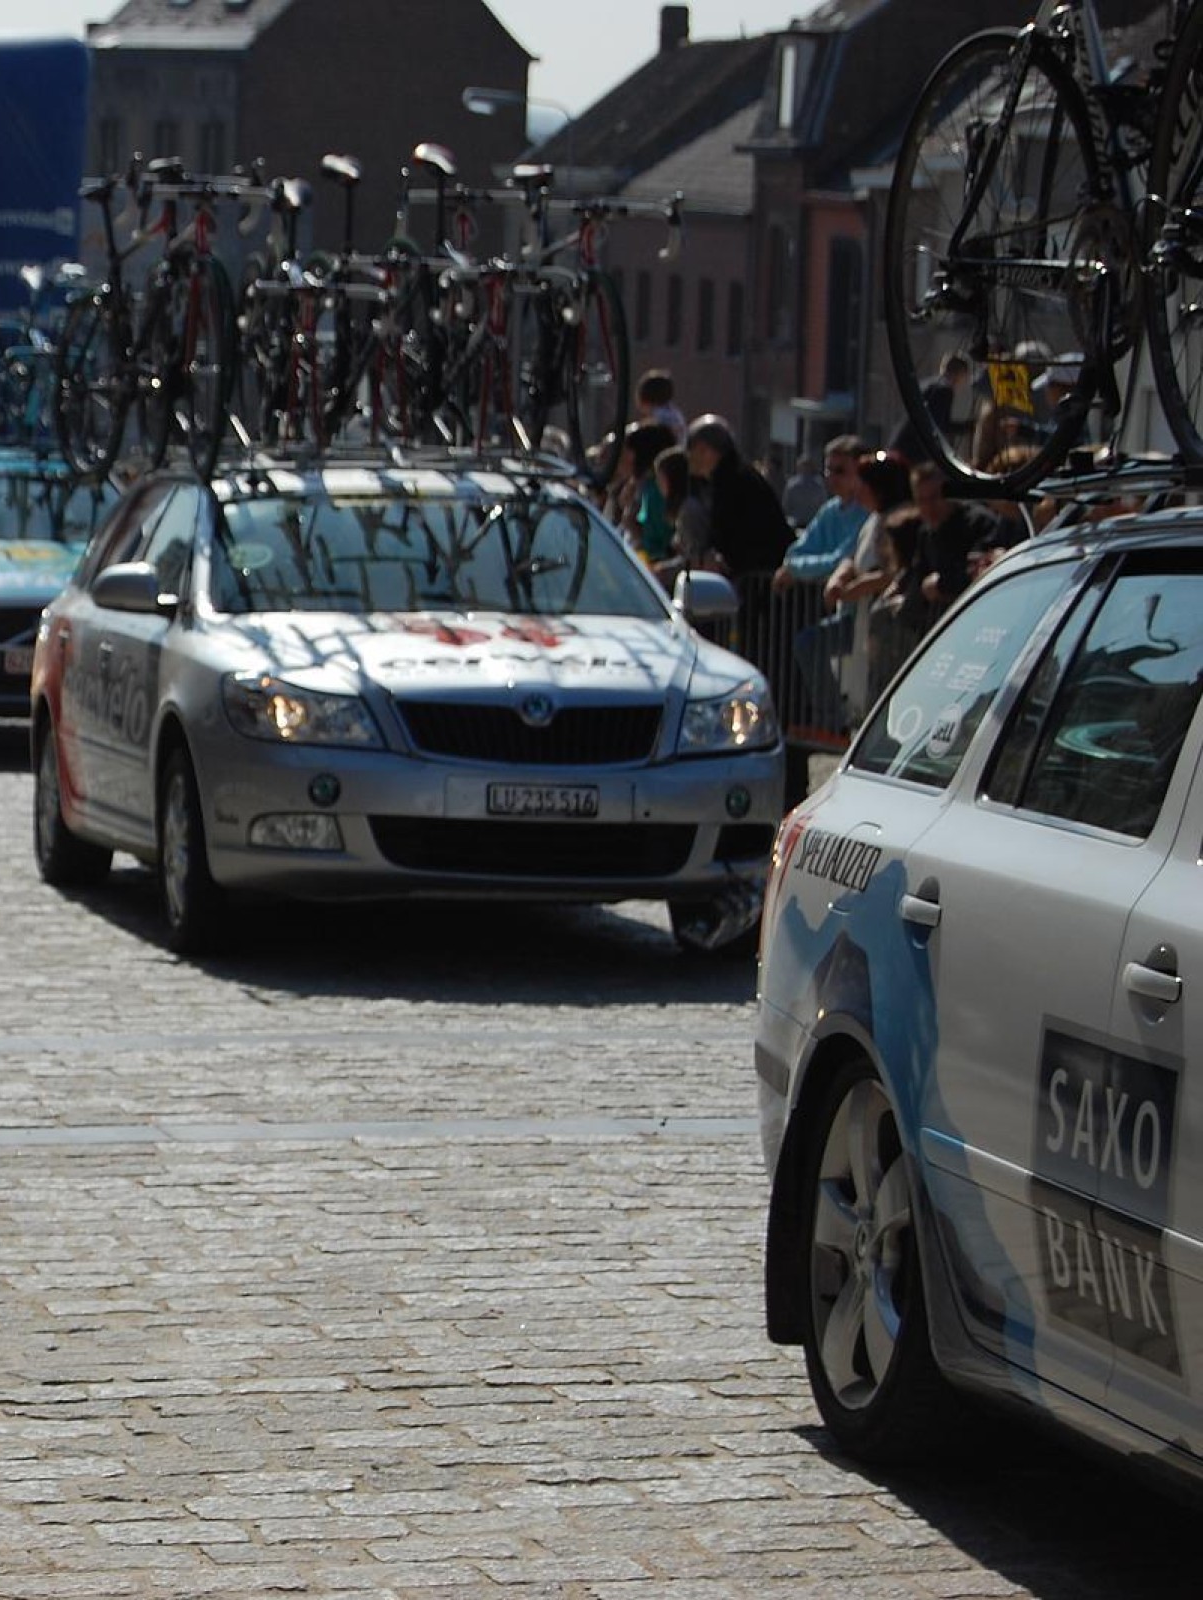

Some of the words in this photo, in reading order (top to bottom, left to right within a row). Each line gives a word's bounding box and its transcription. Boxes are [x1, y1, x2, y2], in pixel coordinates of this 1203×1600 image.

[795, 829, 882, 893] SPECIALIZED
[1047, 1068, 1161, 1189] SAXO
[1044, 1205, 1167, 1336] BANK
